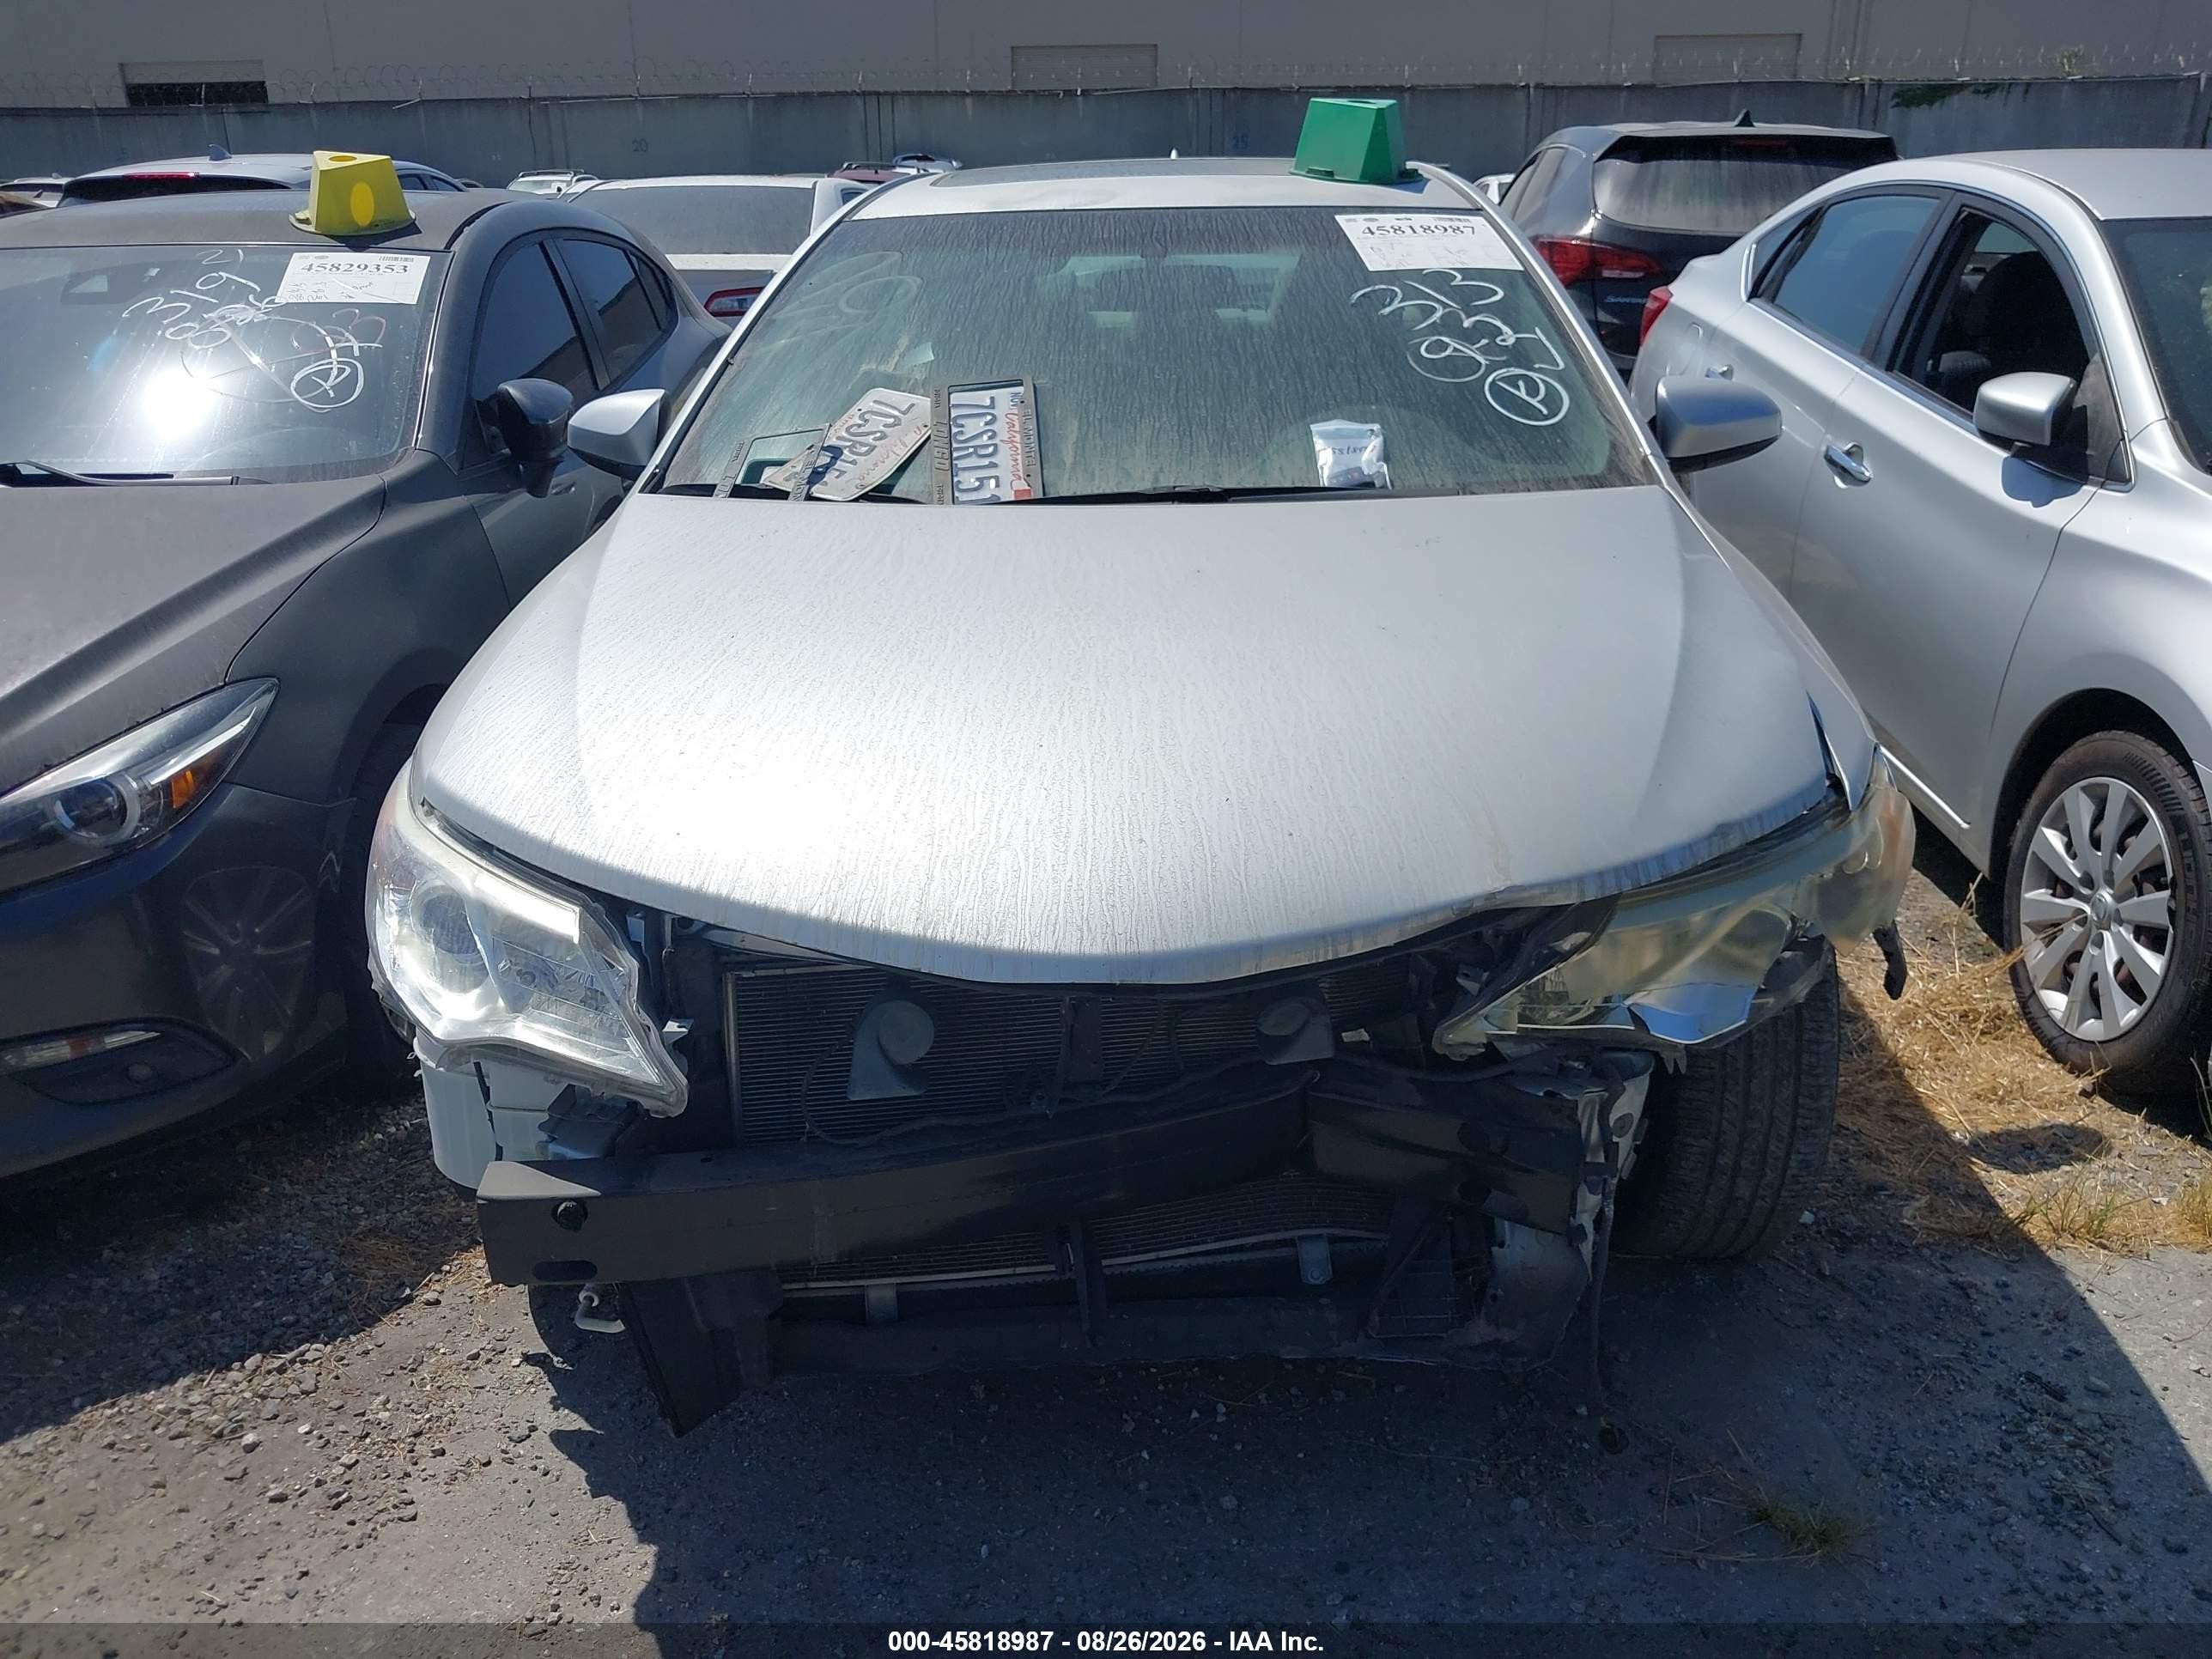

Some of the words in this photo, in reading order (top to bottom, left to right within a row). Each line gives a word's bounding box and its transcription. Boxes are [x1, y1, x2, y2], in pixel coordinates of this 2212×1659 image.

[1362, 224, 1475, 236] 45818987
[301, 262, 409, 274] 45829353
[950, 396, 1001, 504] 7CSR151
